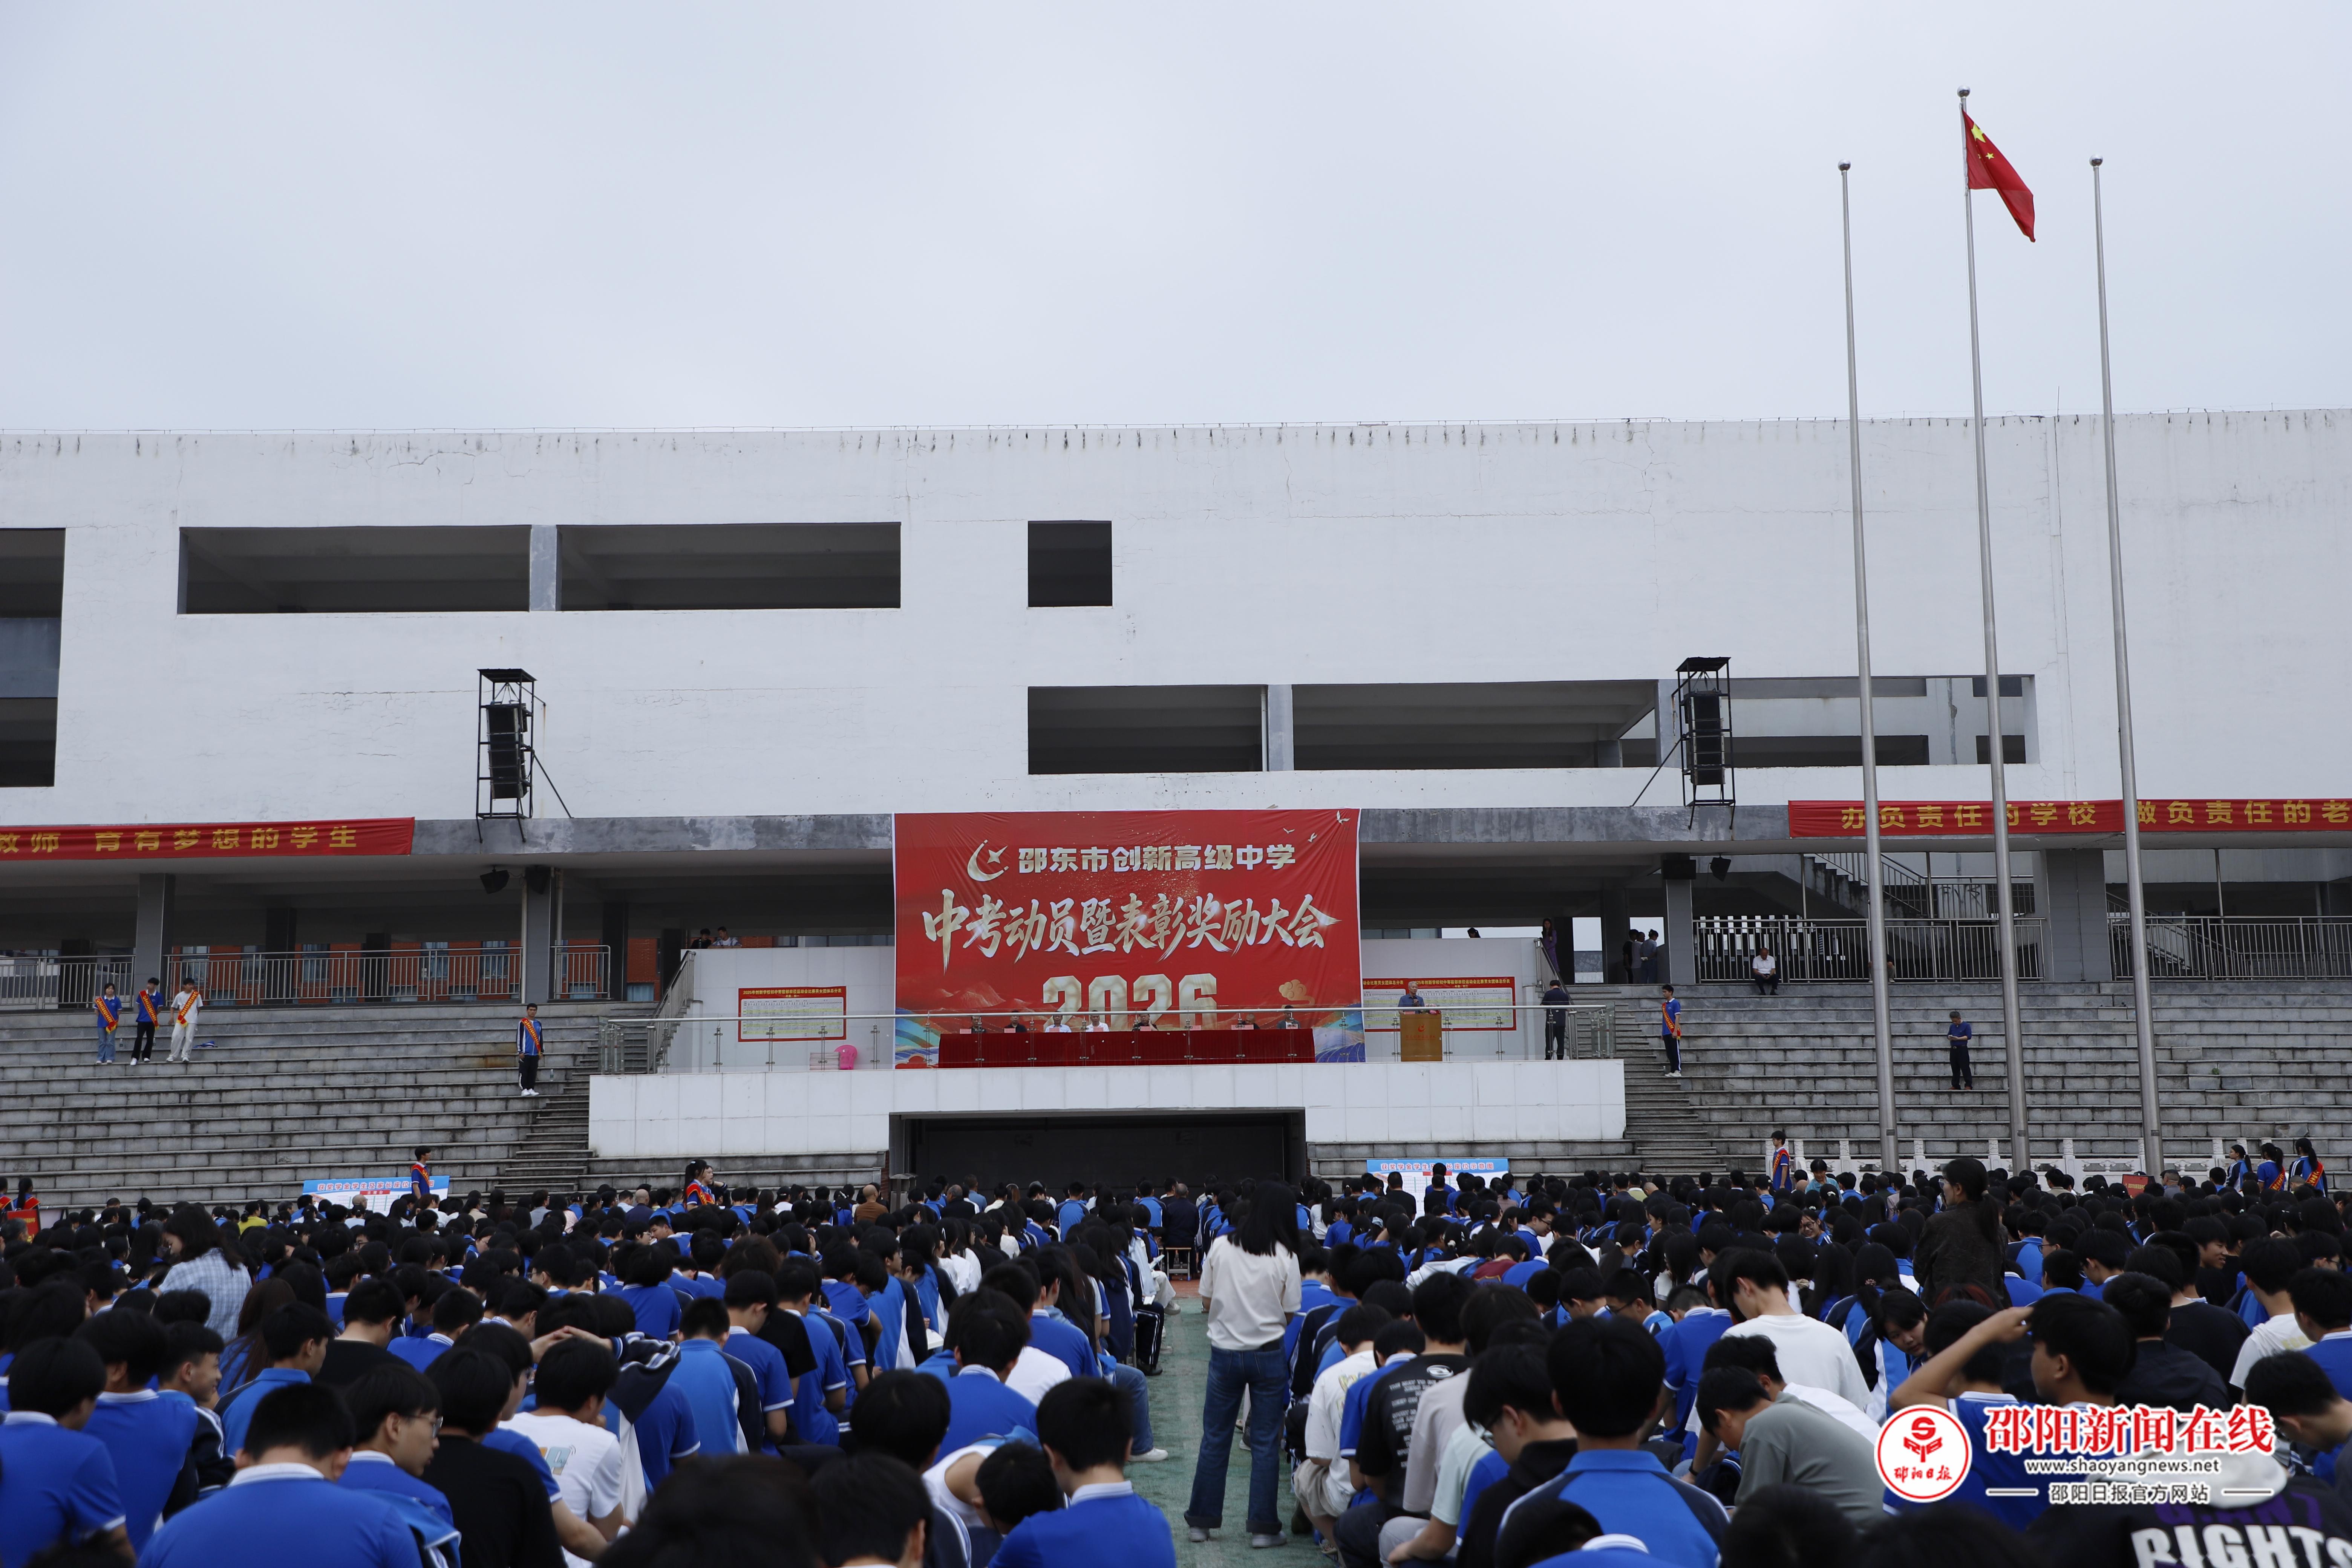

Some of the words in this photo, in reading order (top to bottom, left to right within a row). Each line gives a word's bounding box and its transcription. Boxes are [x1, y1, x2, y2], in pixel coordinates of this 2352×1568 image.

[0, 832, 61, 853] 教师
[95, 825, 357, 852] 育有梦想的学生
[1019, 843, 1296, 873] 邵东市创新高级中学
[922, 888, 1341, 974] 中考动员暨表彰奖励大会
[1043, 973, 1217, 1032] 2026
[1381, 1162, 1494, 1171] 获奖学金学生长座位示意图
[317, 1180, 435, 1191] 获奖学金学生及家长座位图
